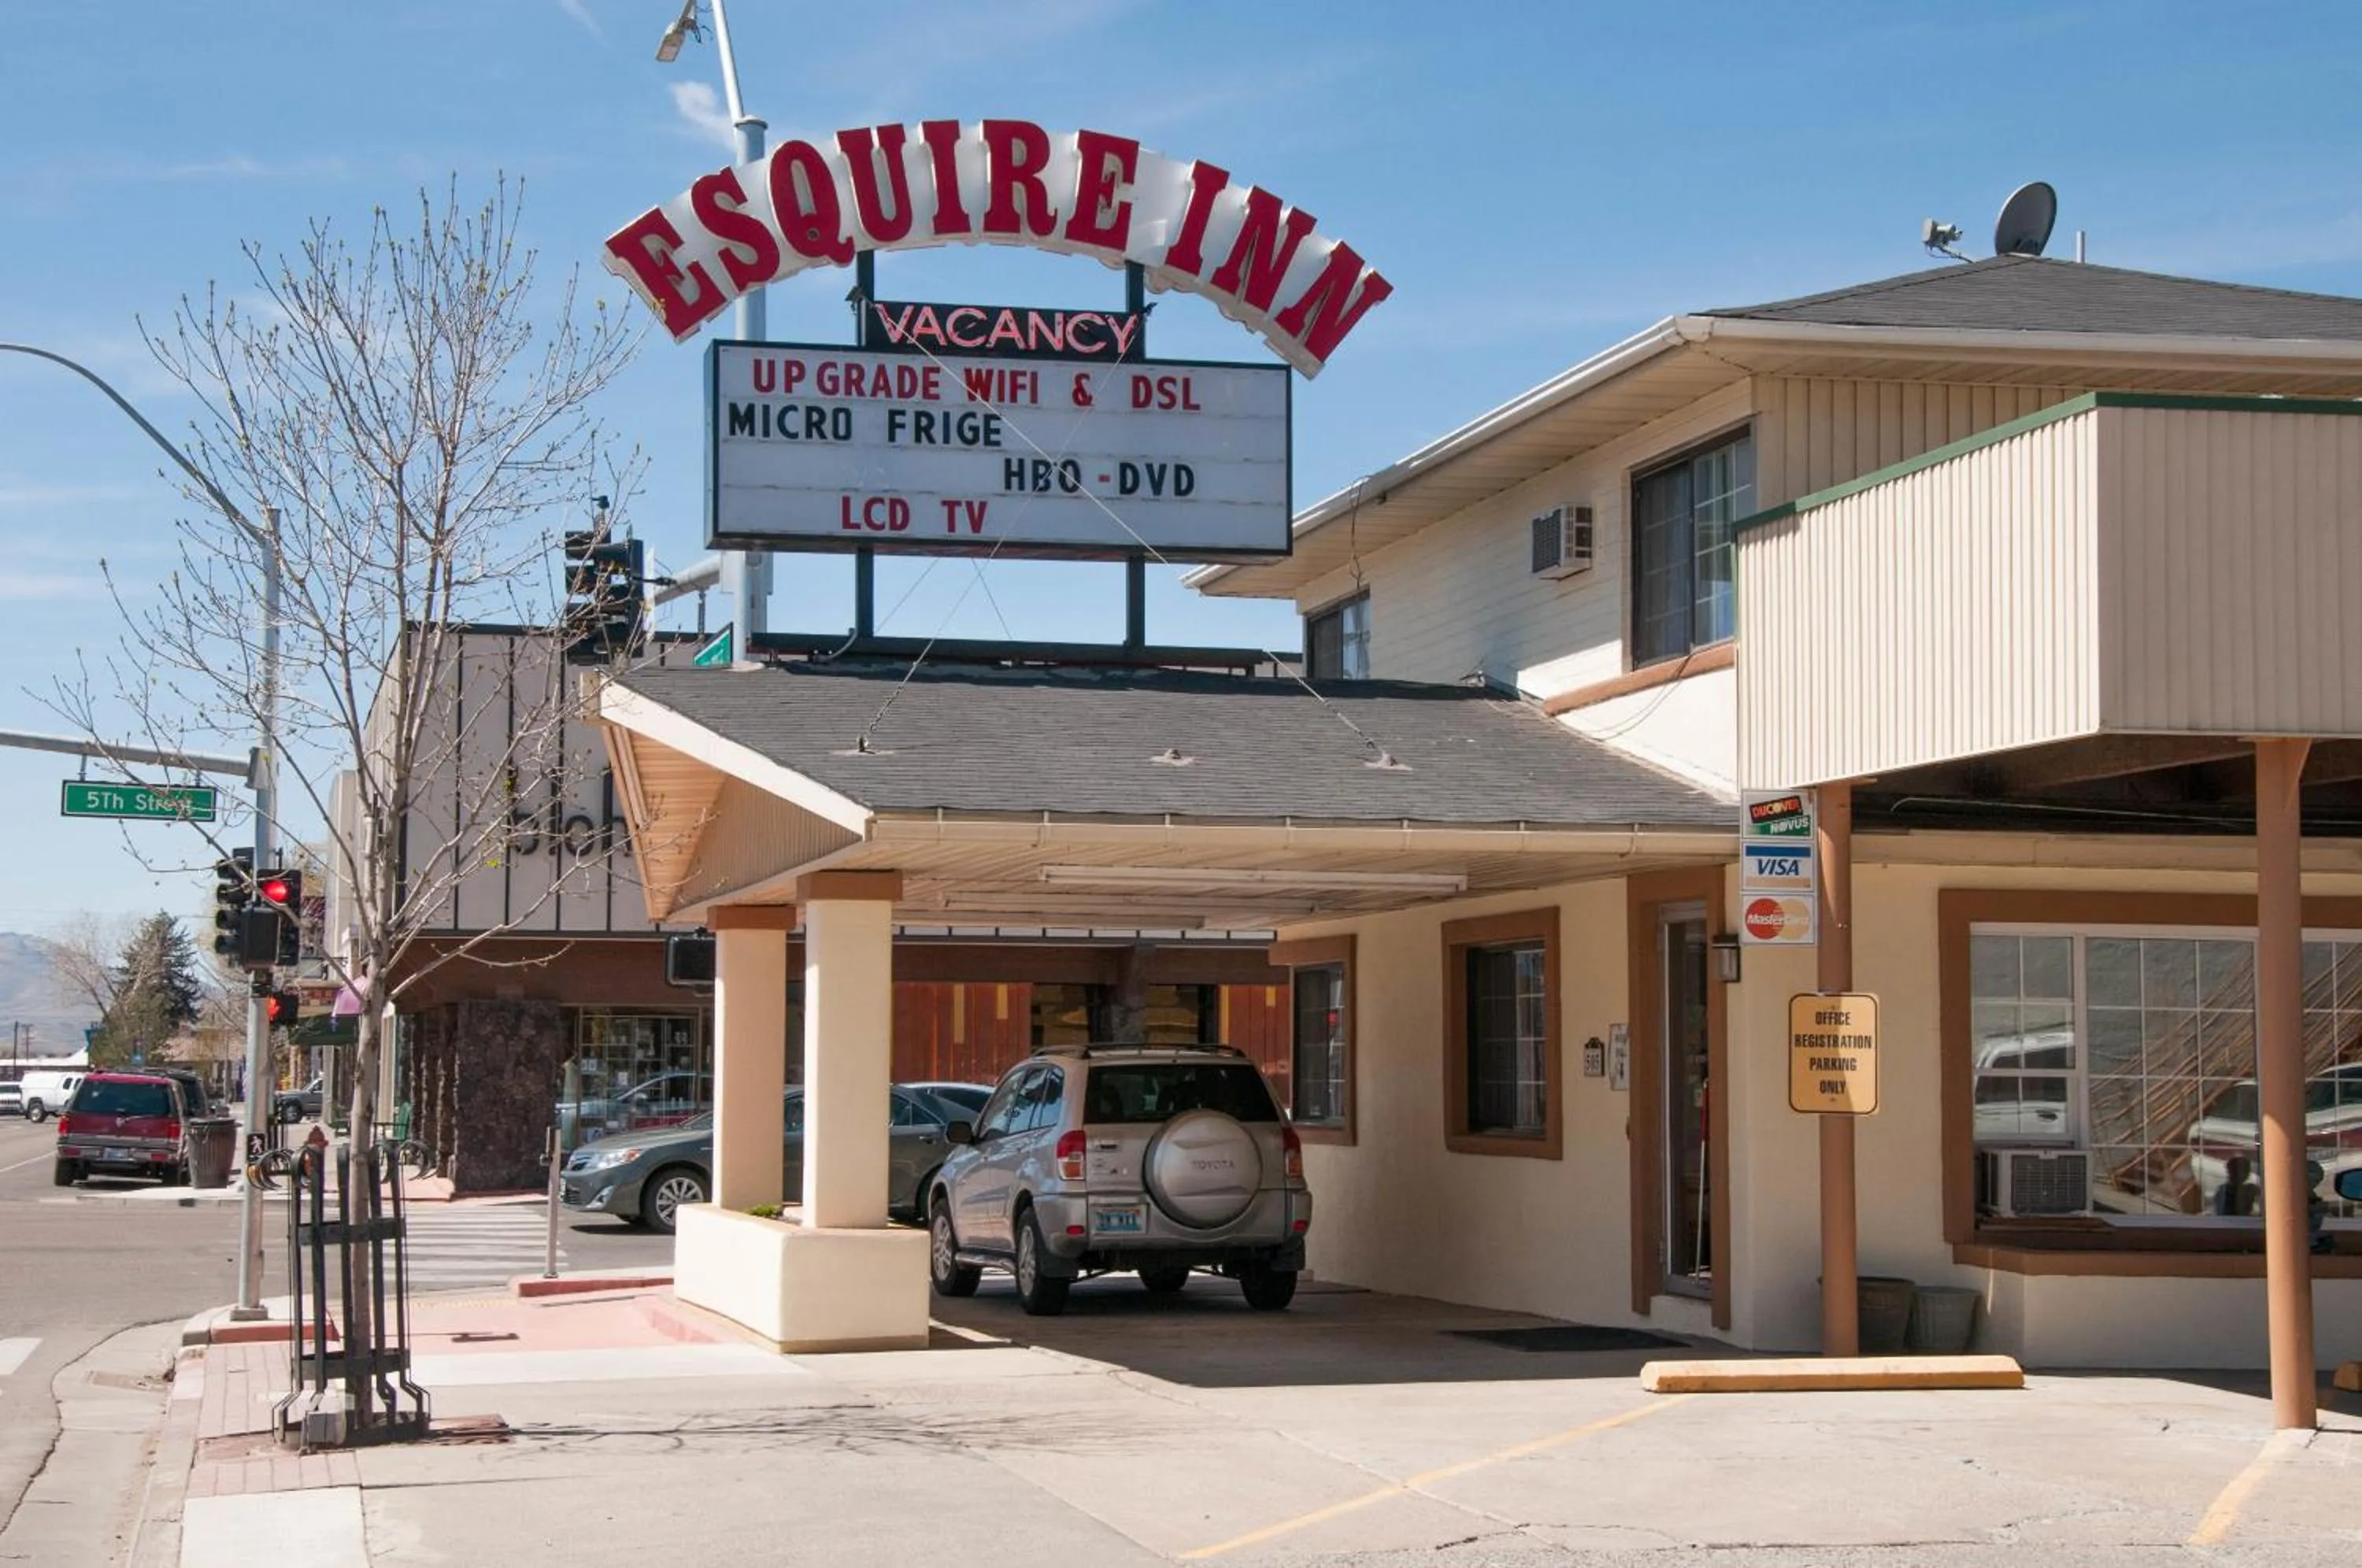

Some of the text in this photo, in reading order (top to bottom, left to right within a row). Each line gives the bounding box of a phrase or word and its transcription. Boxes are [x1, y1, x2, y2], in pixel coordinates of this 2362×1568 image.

[605, 120, 1394, 363] ESQUIRE INN
[874, 302, 1138, 353] VACANCY
[964, 367, 1038, 404] WIFI
[1072, 372, 1094, 406] &
[1131, 375, 1201, 411] DSL
[728, 401, 1002, 447] MICRO FRIGE
[1004, 458, 1081, 494] HBO
[842, 496, 988, 534] LCD TV
[87, 791, 191, 816] 5Th Stre
[1769, 816, 1809, 834] NOVUS
[1757, 859, 1800, 876] VISA
[1815, 1011, 1852, 1026] OFFICE
[1794, 1034, 1872, 1049] REGISTRATION
[1809, 1057, 1857, 1071] PARKING
[1819, 1079, 1846, 1094] ONLY
